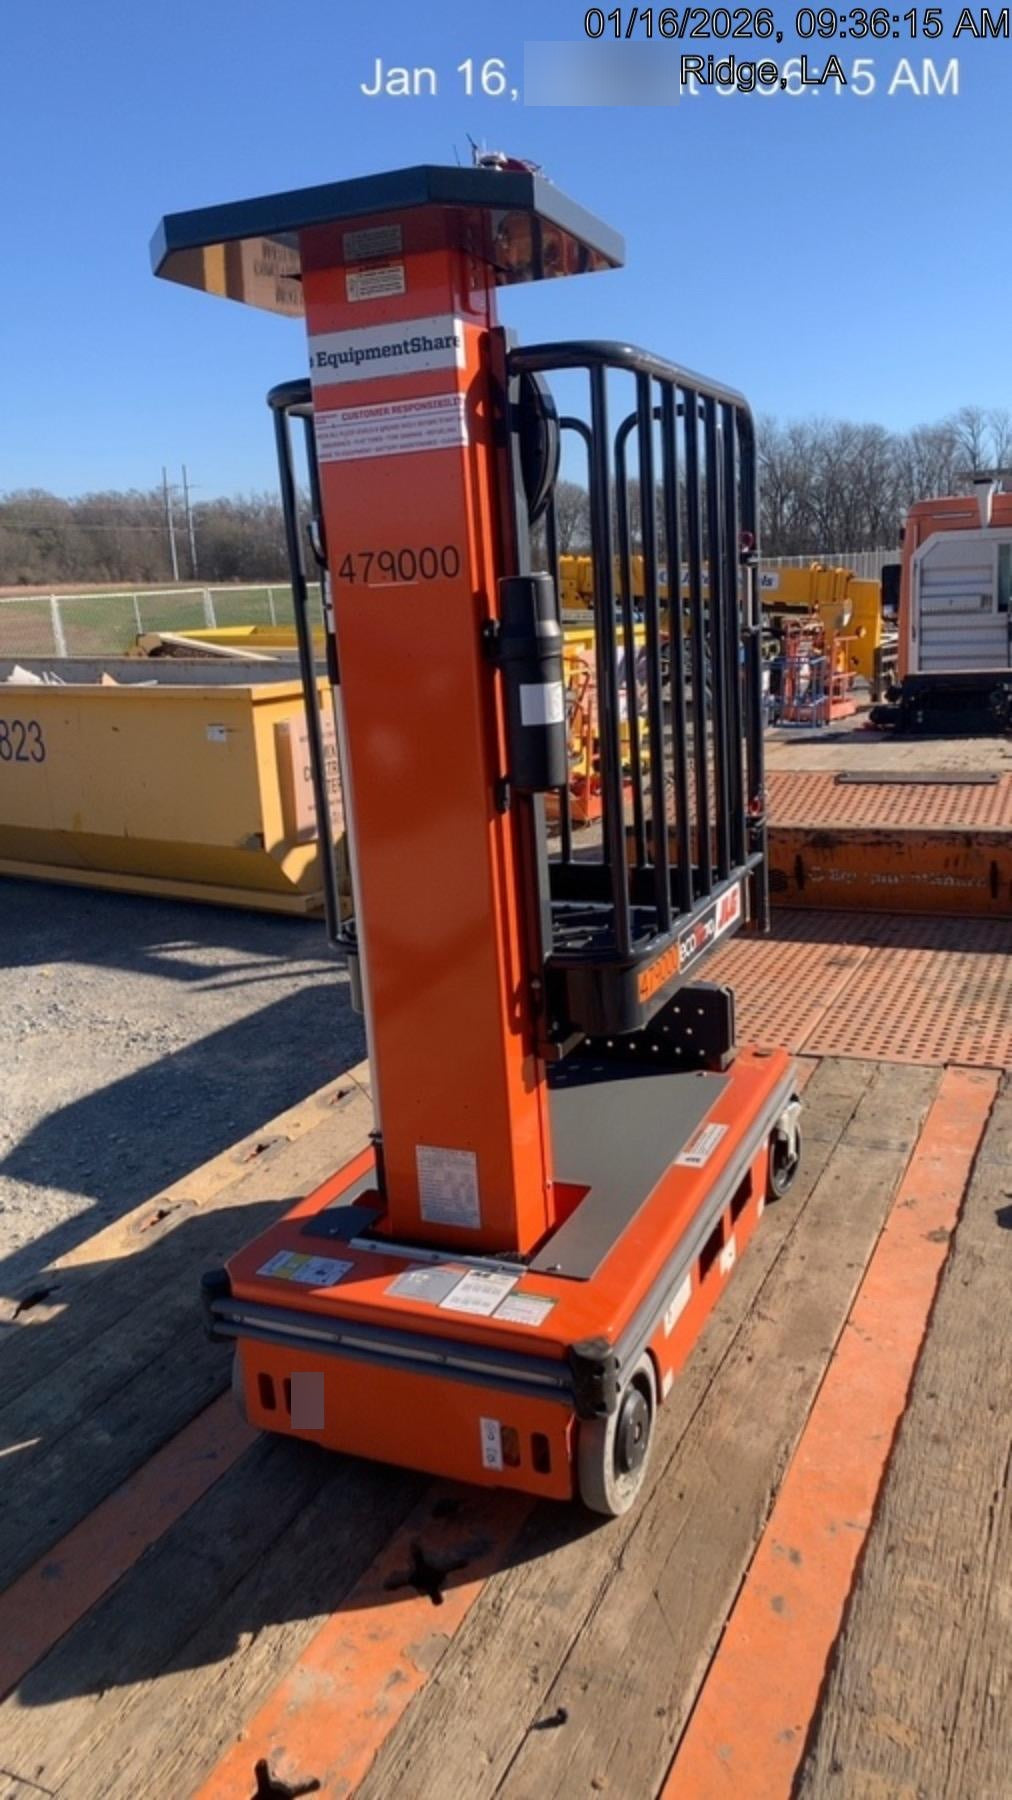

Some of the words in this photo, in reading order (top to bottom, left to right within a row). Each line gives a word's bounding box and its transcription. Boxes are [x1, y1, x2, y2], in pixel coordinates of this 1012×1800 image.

[316, 335, 461, 369] EquipmentShare
[338, 545, 460, 584] 479000
[0, 719, 46, 763] 823
